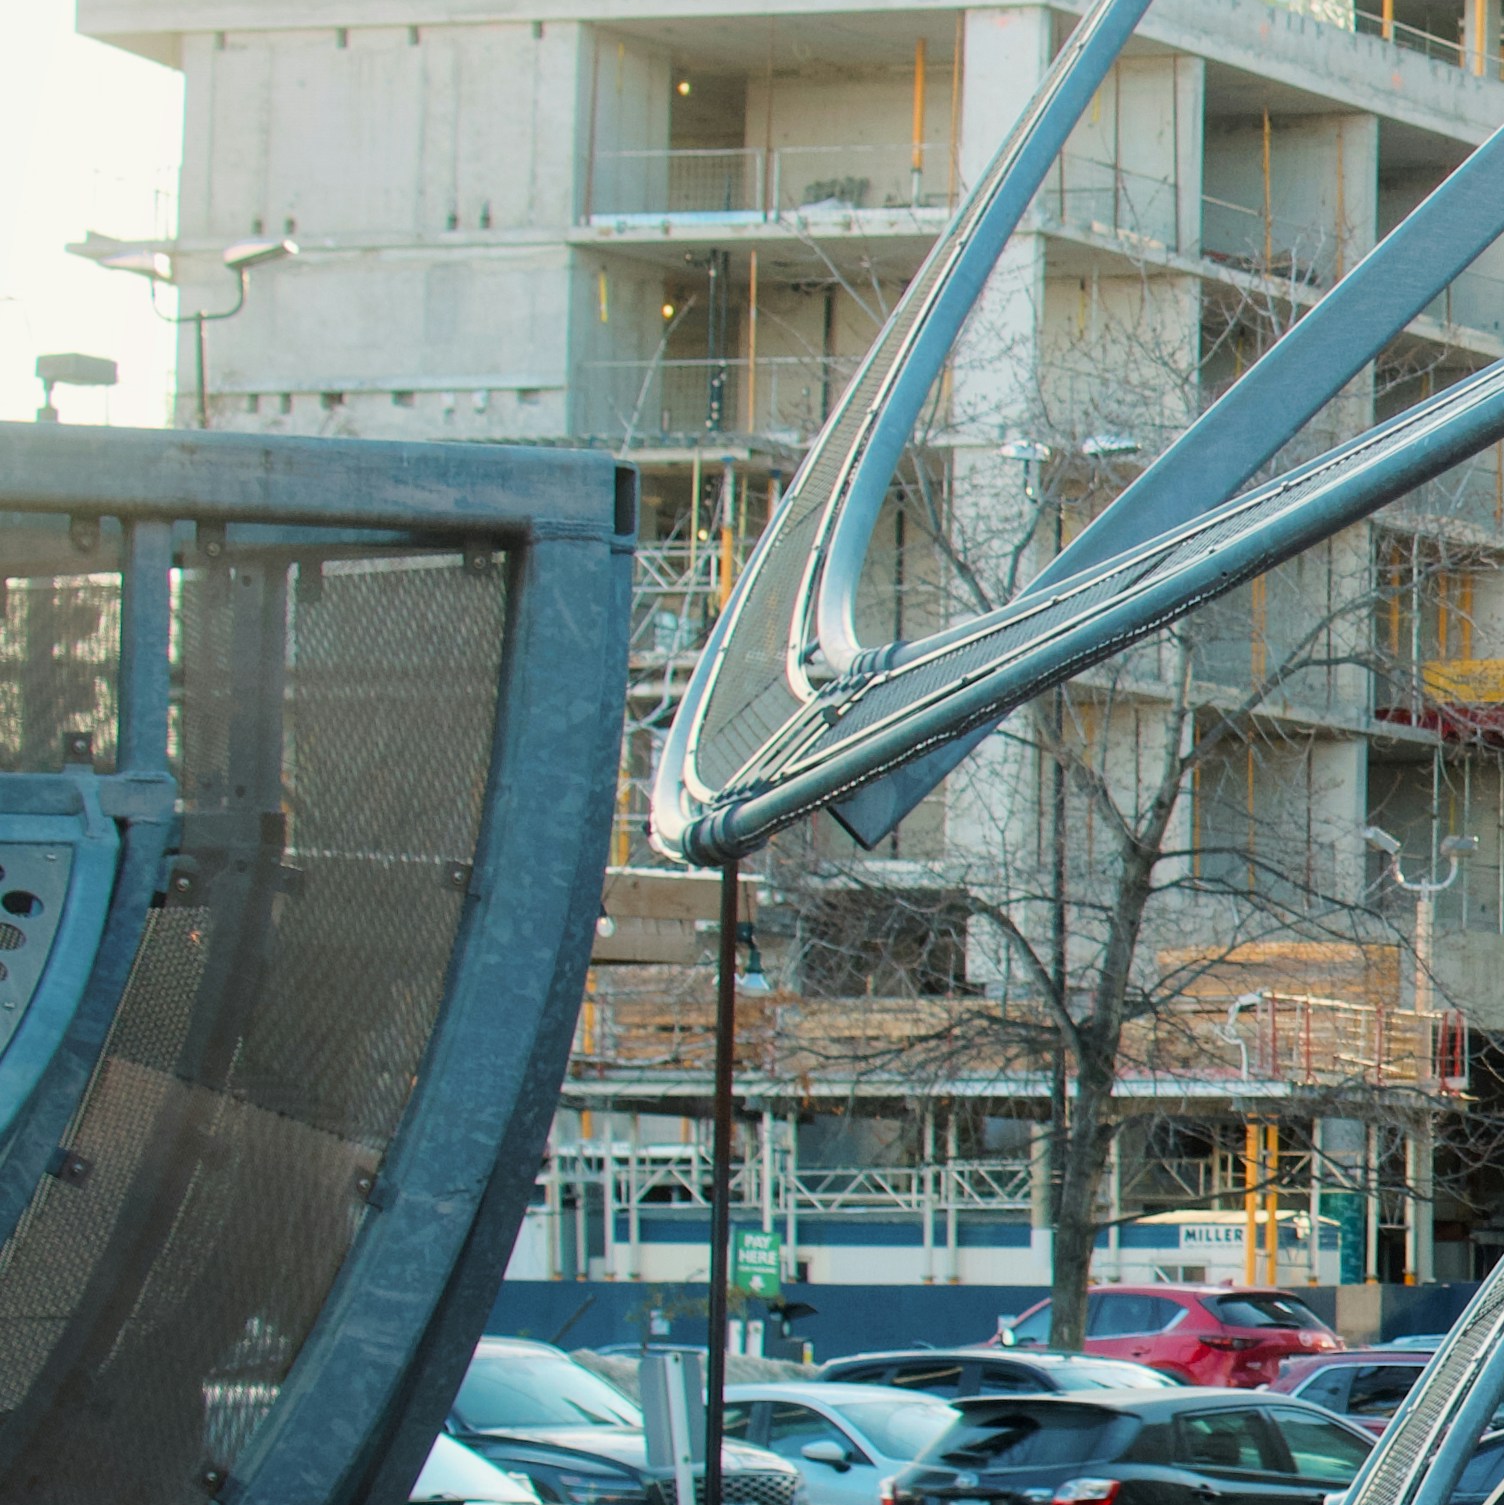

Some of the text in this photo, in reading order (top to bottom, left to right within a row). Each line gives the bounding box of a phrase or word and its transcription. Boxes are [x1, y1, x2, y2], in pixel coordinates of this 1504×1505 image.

[744, 1233, 772, 1249] PAY
[1184, 1228, 1244, 1242] MILLER
[739, 1248, 775, 1265] HERE
